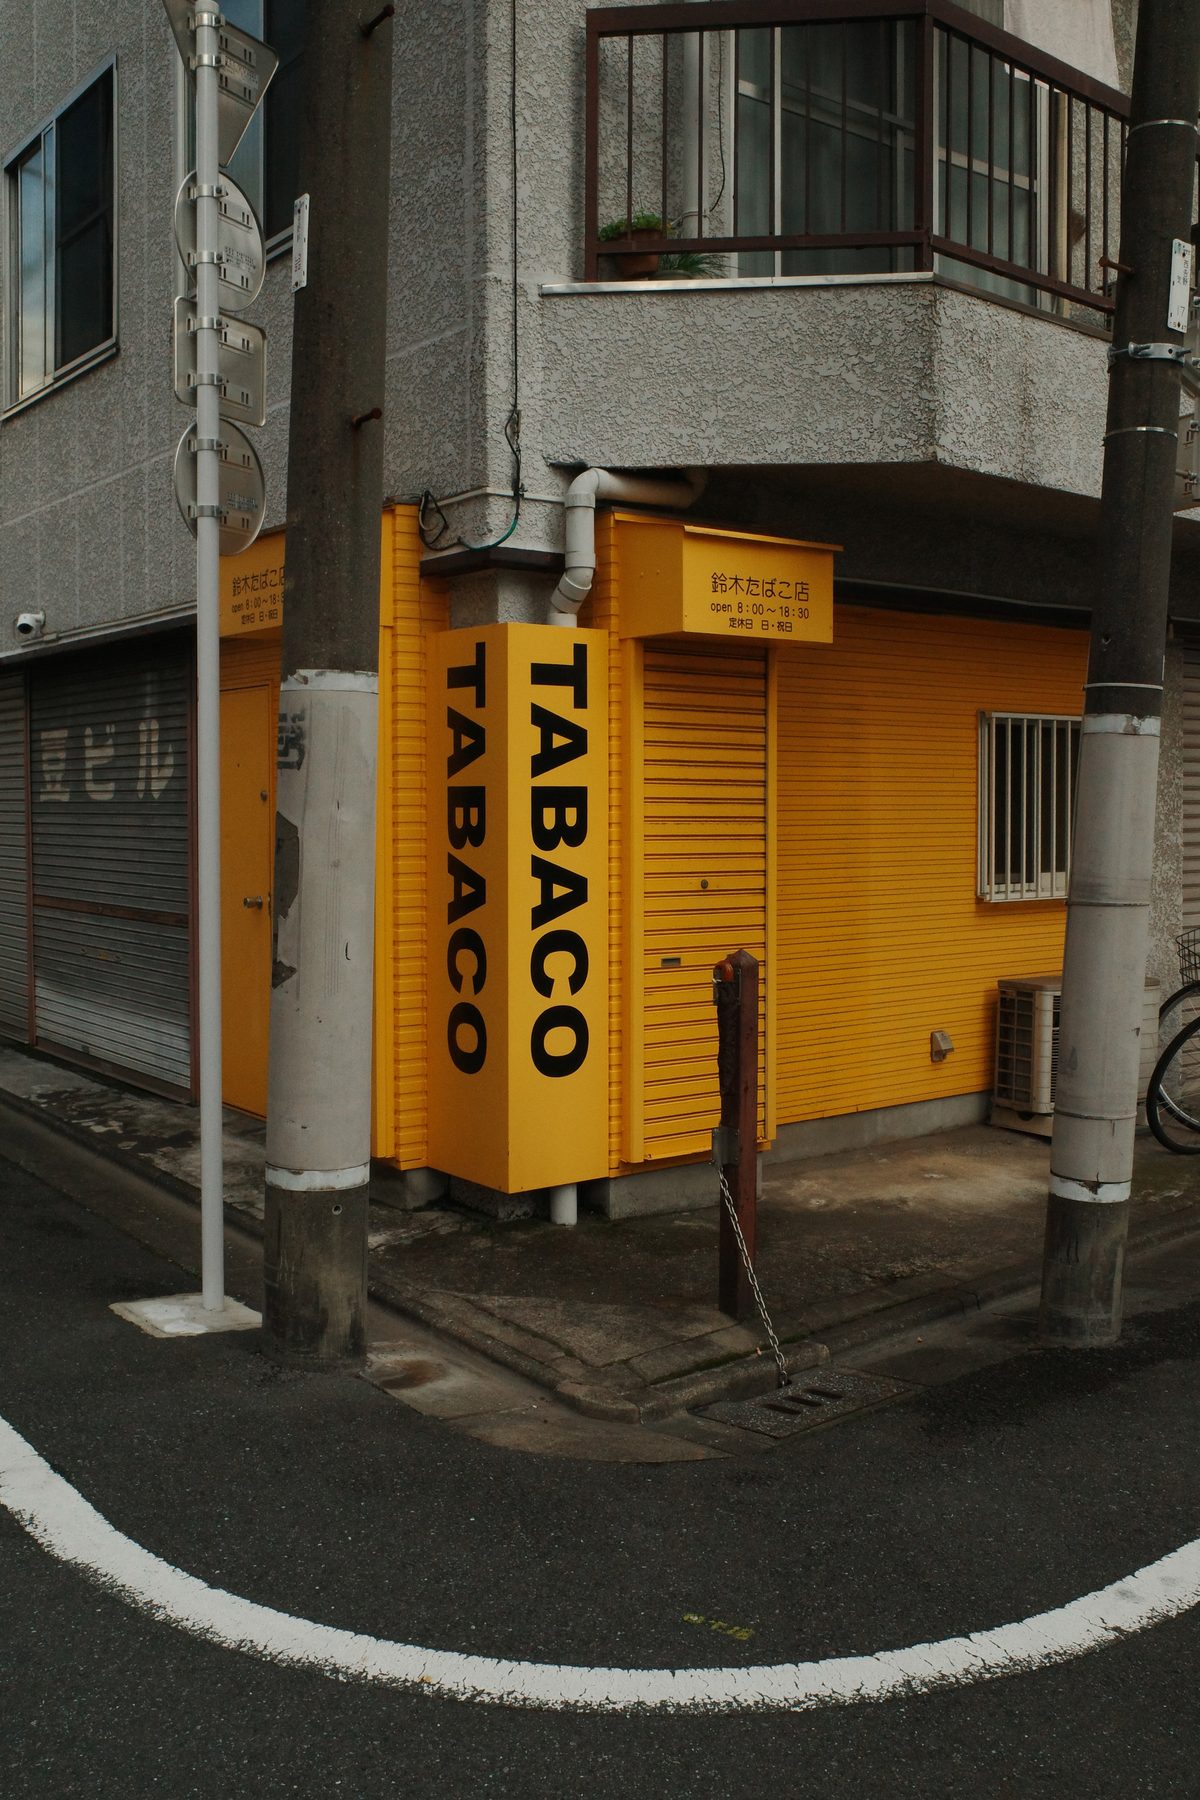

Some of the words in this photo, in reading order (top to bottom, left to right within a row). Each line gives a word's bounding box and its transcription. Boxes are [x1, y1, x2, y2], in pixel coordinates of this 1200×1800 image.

[711, 572, 810, 602] 鈴木たばこ店
[710, 602, 733, 613] open
[728, 617, 753, 630] 定休日
[447, 641, 488, 1075] TABACO
[530, 643, 589, 1078] TABACO
